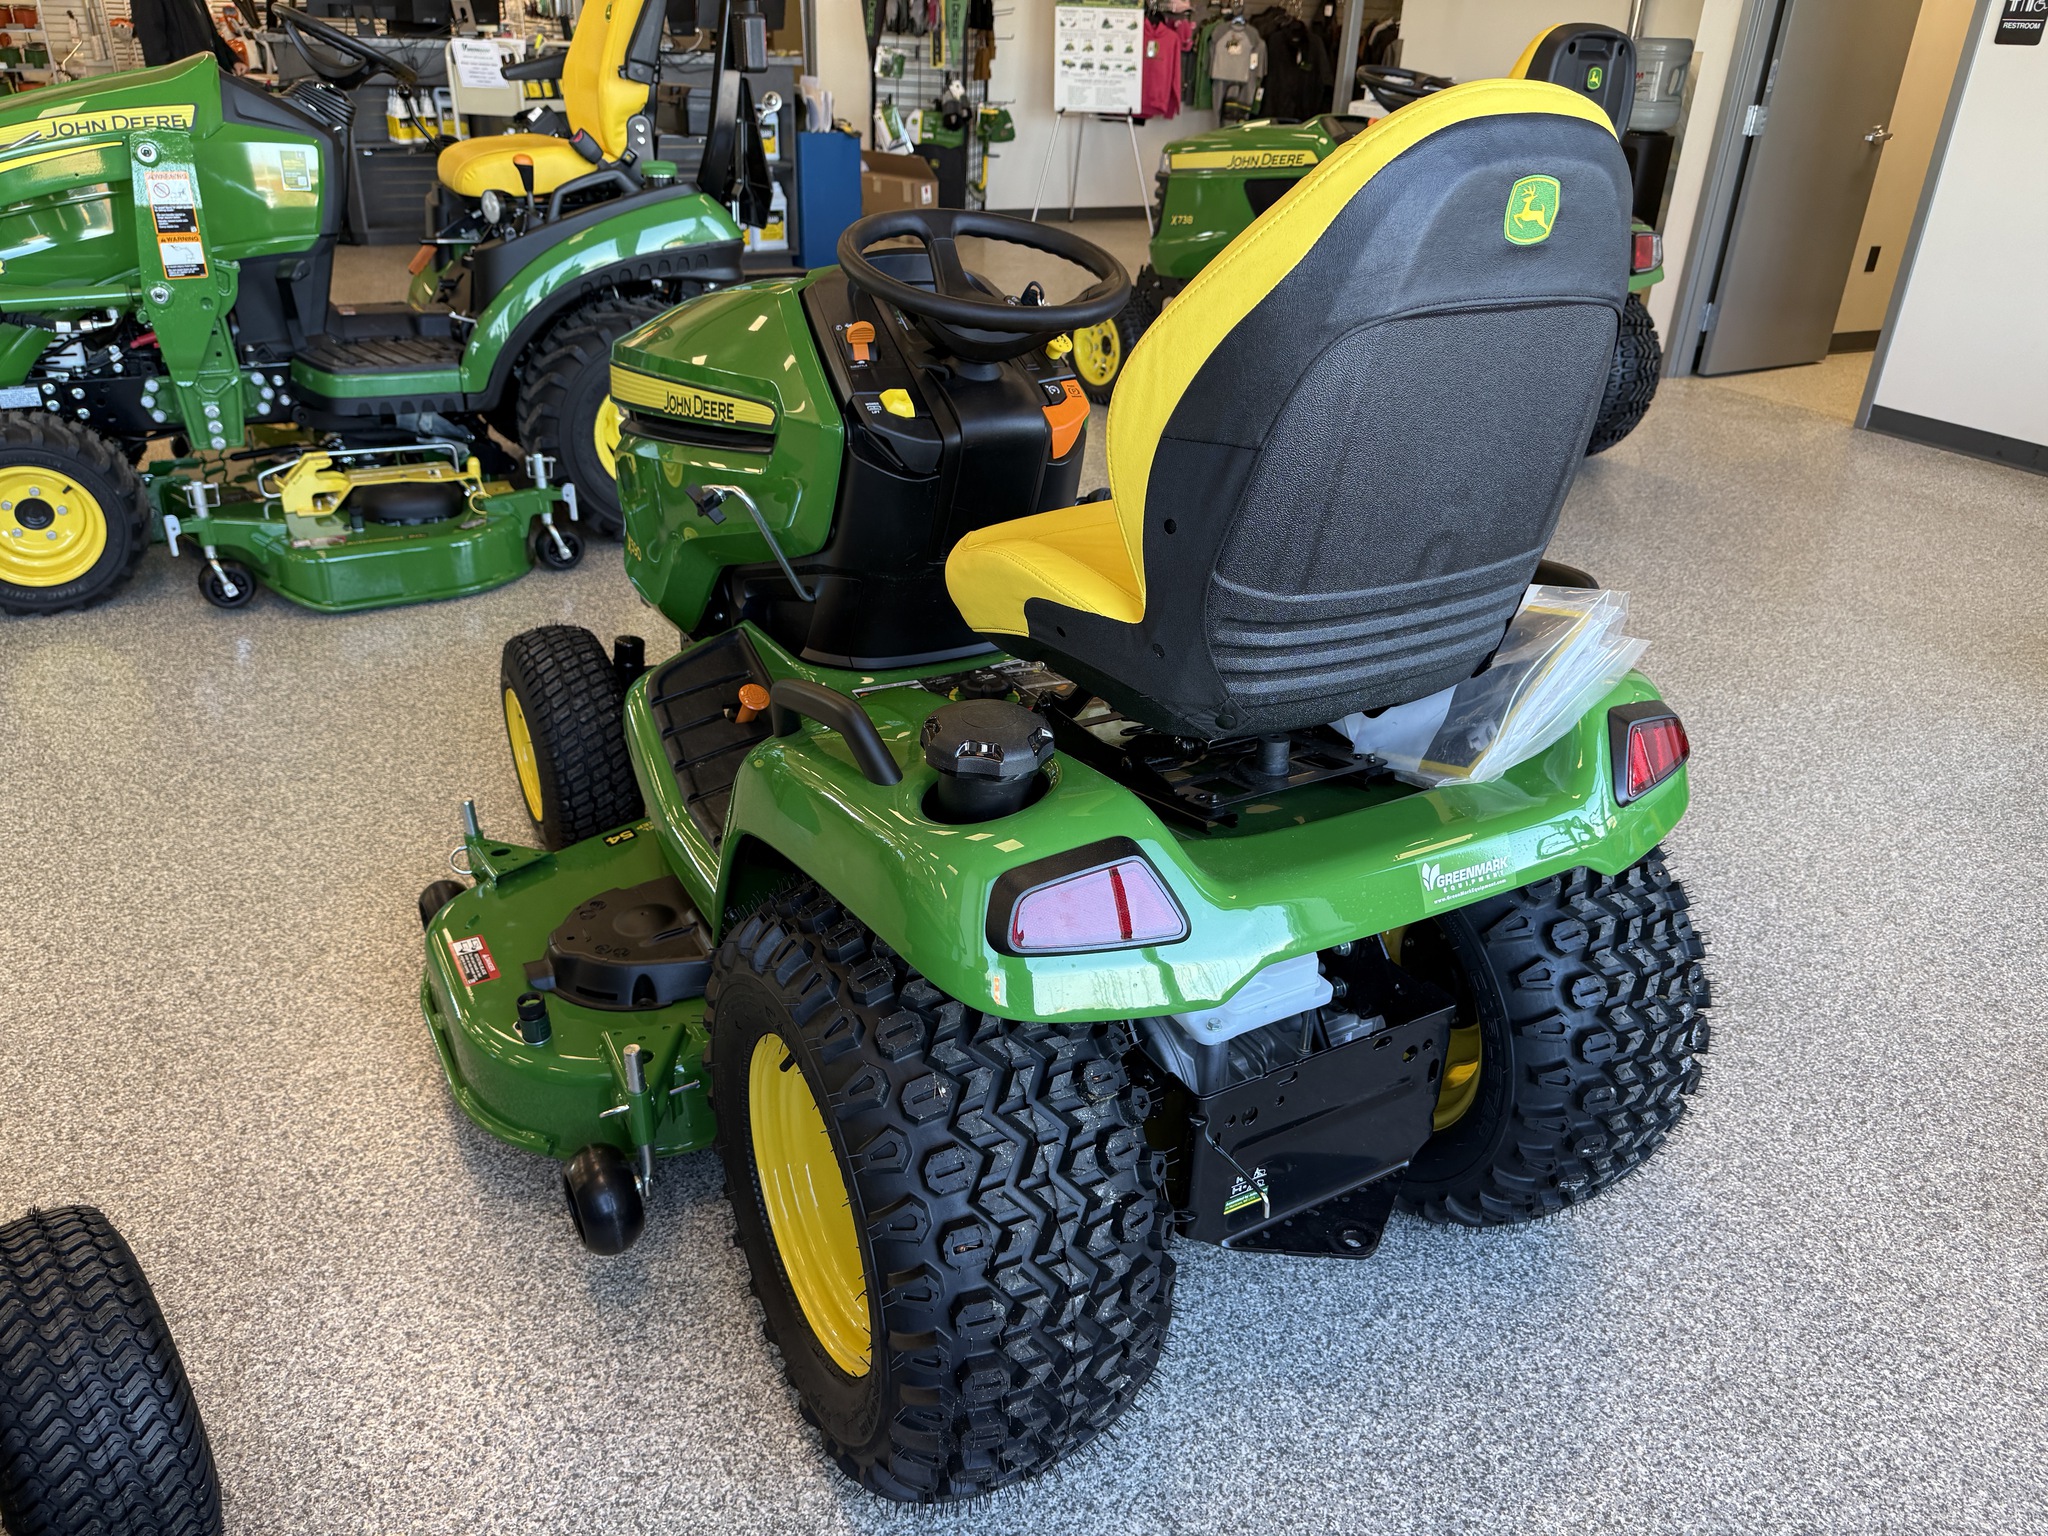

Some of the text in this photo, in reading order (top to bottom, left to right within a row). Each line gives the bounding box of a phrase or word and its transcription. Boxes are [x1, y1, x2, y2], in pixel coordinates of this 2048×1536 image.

[46, 114, 183, 139] JOHN DEERE
[1227, 153, 1305, 168] JOHN DEERE
[664, 390, 734, 421] JOHN DEERE
[605, 830, 635, 844] 54
[1436, 856, 1508, 888] GREENMARK
[1443, 870, 1504, 893] EQUIPMENT
[1433, 879, 1507, 904] www.GreenMarkEquipment.com
